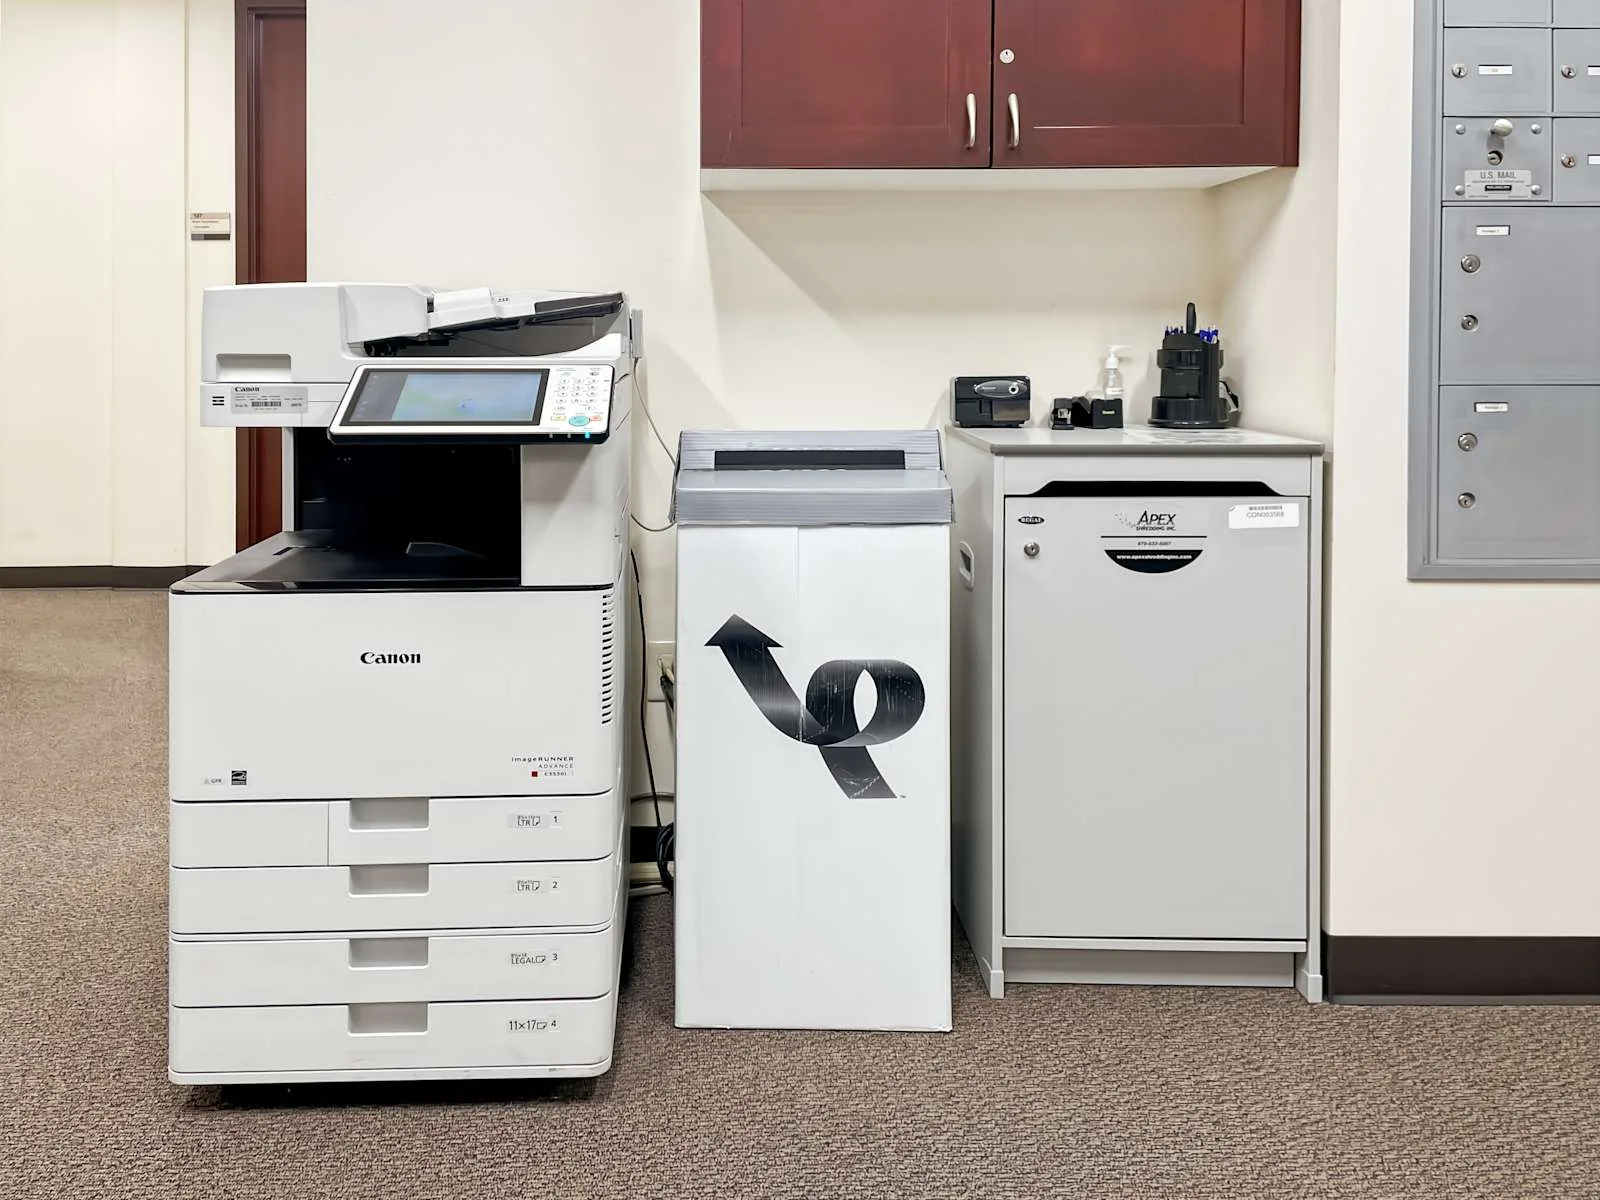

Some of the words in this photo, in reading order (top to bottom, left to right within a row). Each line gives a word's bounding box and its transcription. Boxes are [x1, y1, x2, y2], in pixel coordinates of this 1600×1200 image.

[1497, 171, 1516, 179] MAIL
[1137, 509, 1176, 525] APEX
[360, 651, 422, 664] Canon
[553, 815, 558, 823] 1
[552, 880, 558, 889] 2
[511, 956, 536, 965] LEGAL
[552, 952, 558, 961] 3
[551, 1019, 557, 1027] 4
